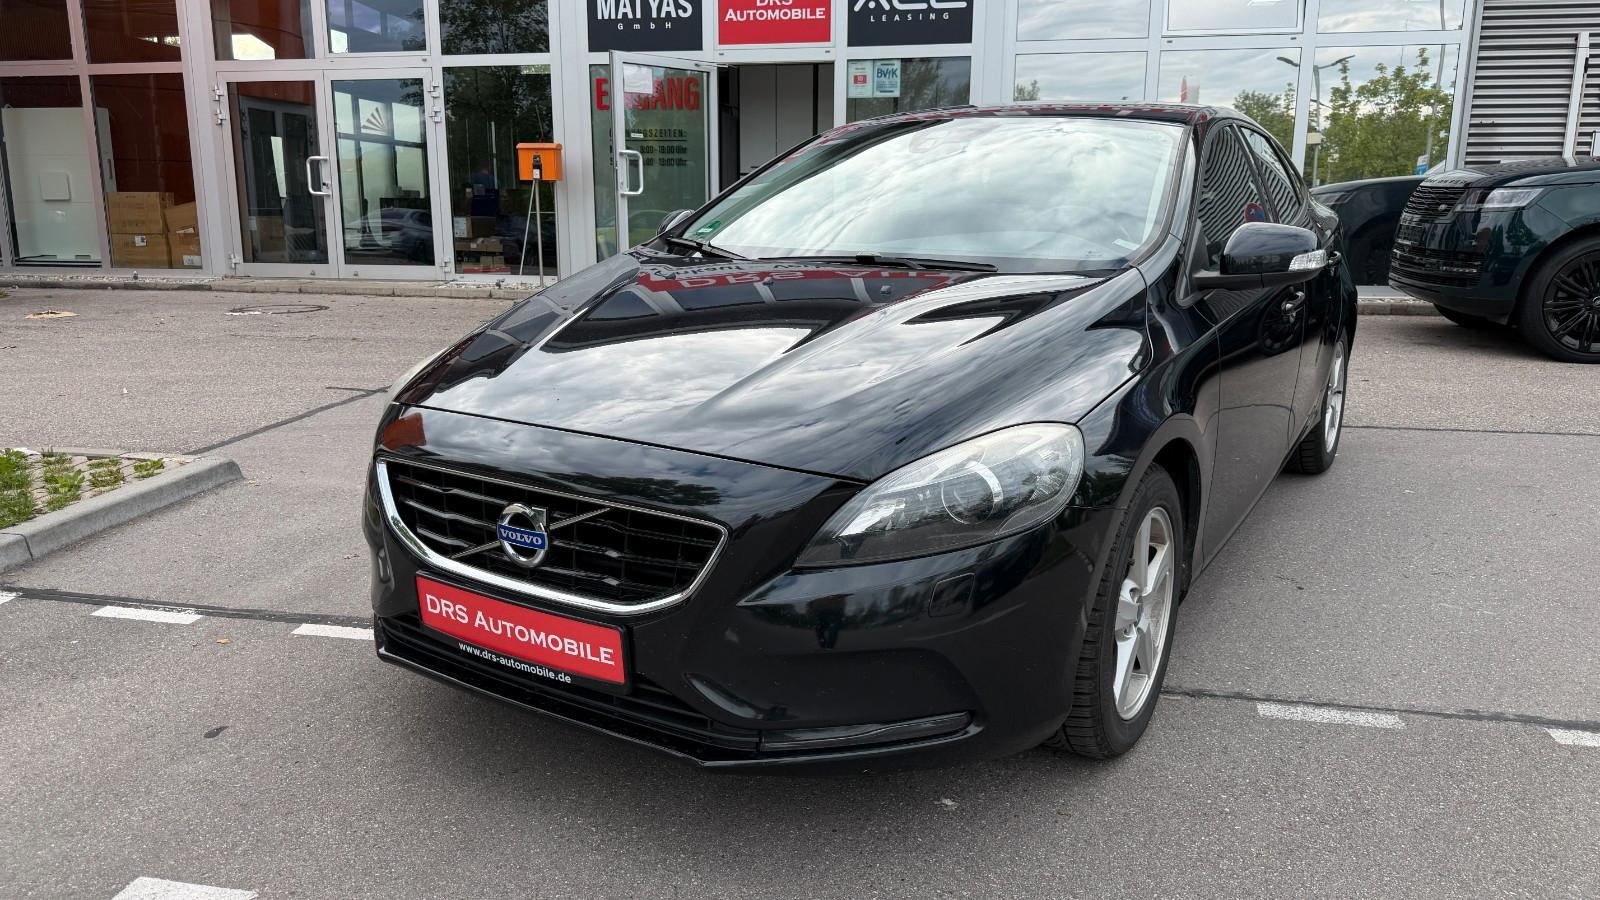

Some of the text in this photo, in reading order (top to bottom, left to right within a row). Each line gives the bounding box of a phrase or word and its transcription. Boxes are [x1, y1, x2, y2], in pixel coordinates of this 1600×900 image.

[724, 8, 826, 22] AUTOMOBILE
[870, 12, 949, 22] LEASING
[617, 22, 672, 31] GmbH
[499, 527, 543, 546] VOLVO
[425, 594, 615, 666] DRS AUTOMOBILE
[458, 641, 572, 684] www.drs-automobile.de
